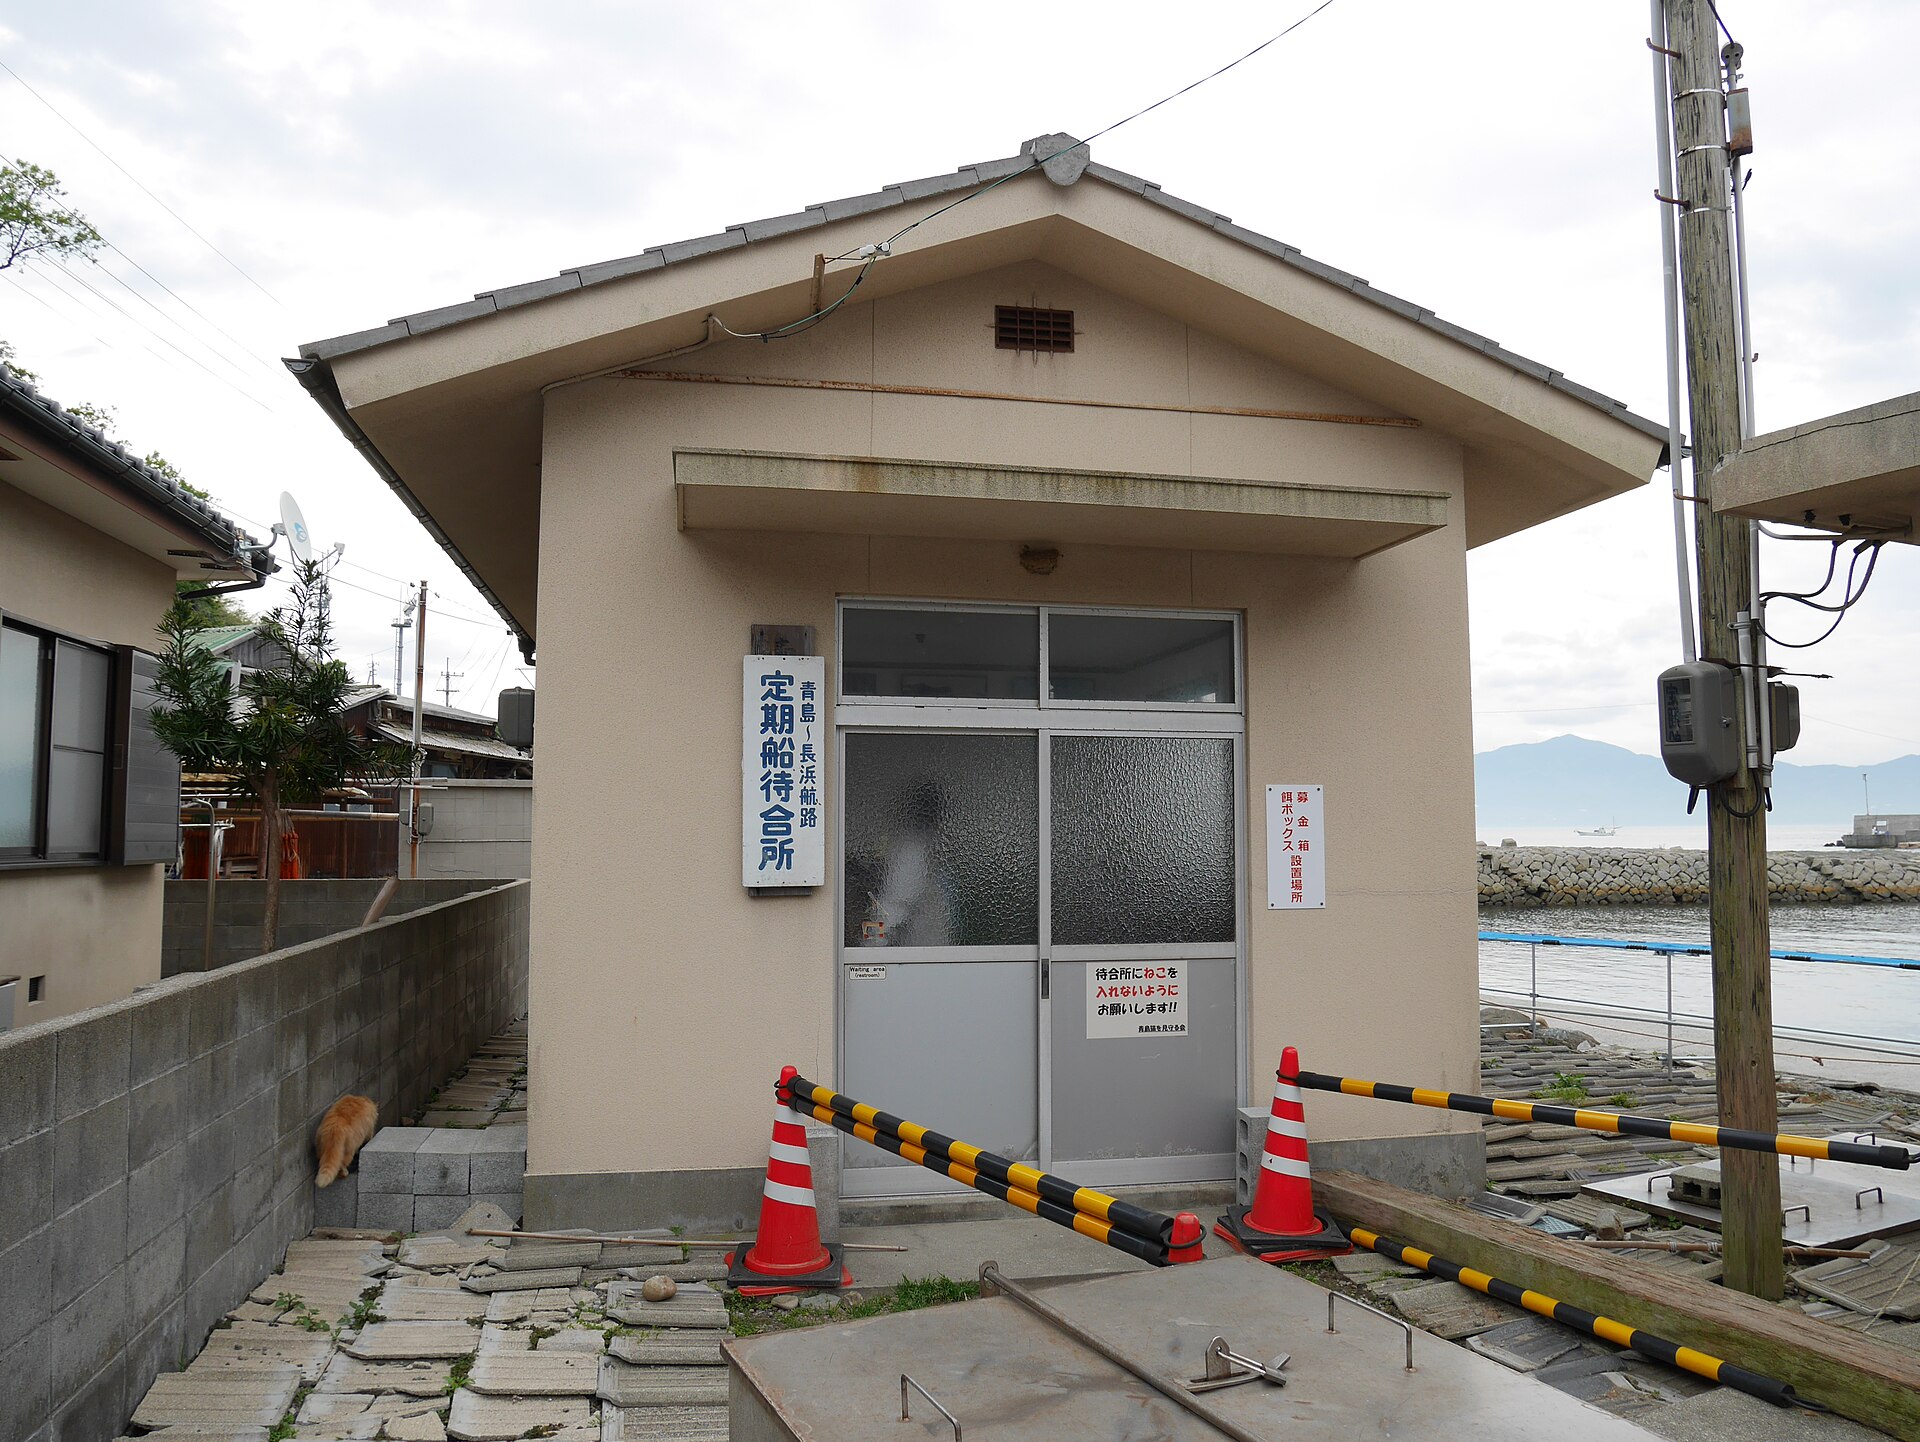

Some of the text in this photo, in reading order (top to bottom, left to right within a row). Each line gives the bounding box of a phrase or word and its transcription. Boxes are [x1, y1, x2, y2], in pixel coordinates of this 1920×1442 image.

[758, 670, 794, 870] 定期船待合所
[1290, 855, 1303, 903] 設置場所
[1095, 967, 1178, 981] 待合所にねこを
[1096, 985, 1179, 998] 入れないように
